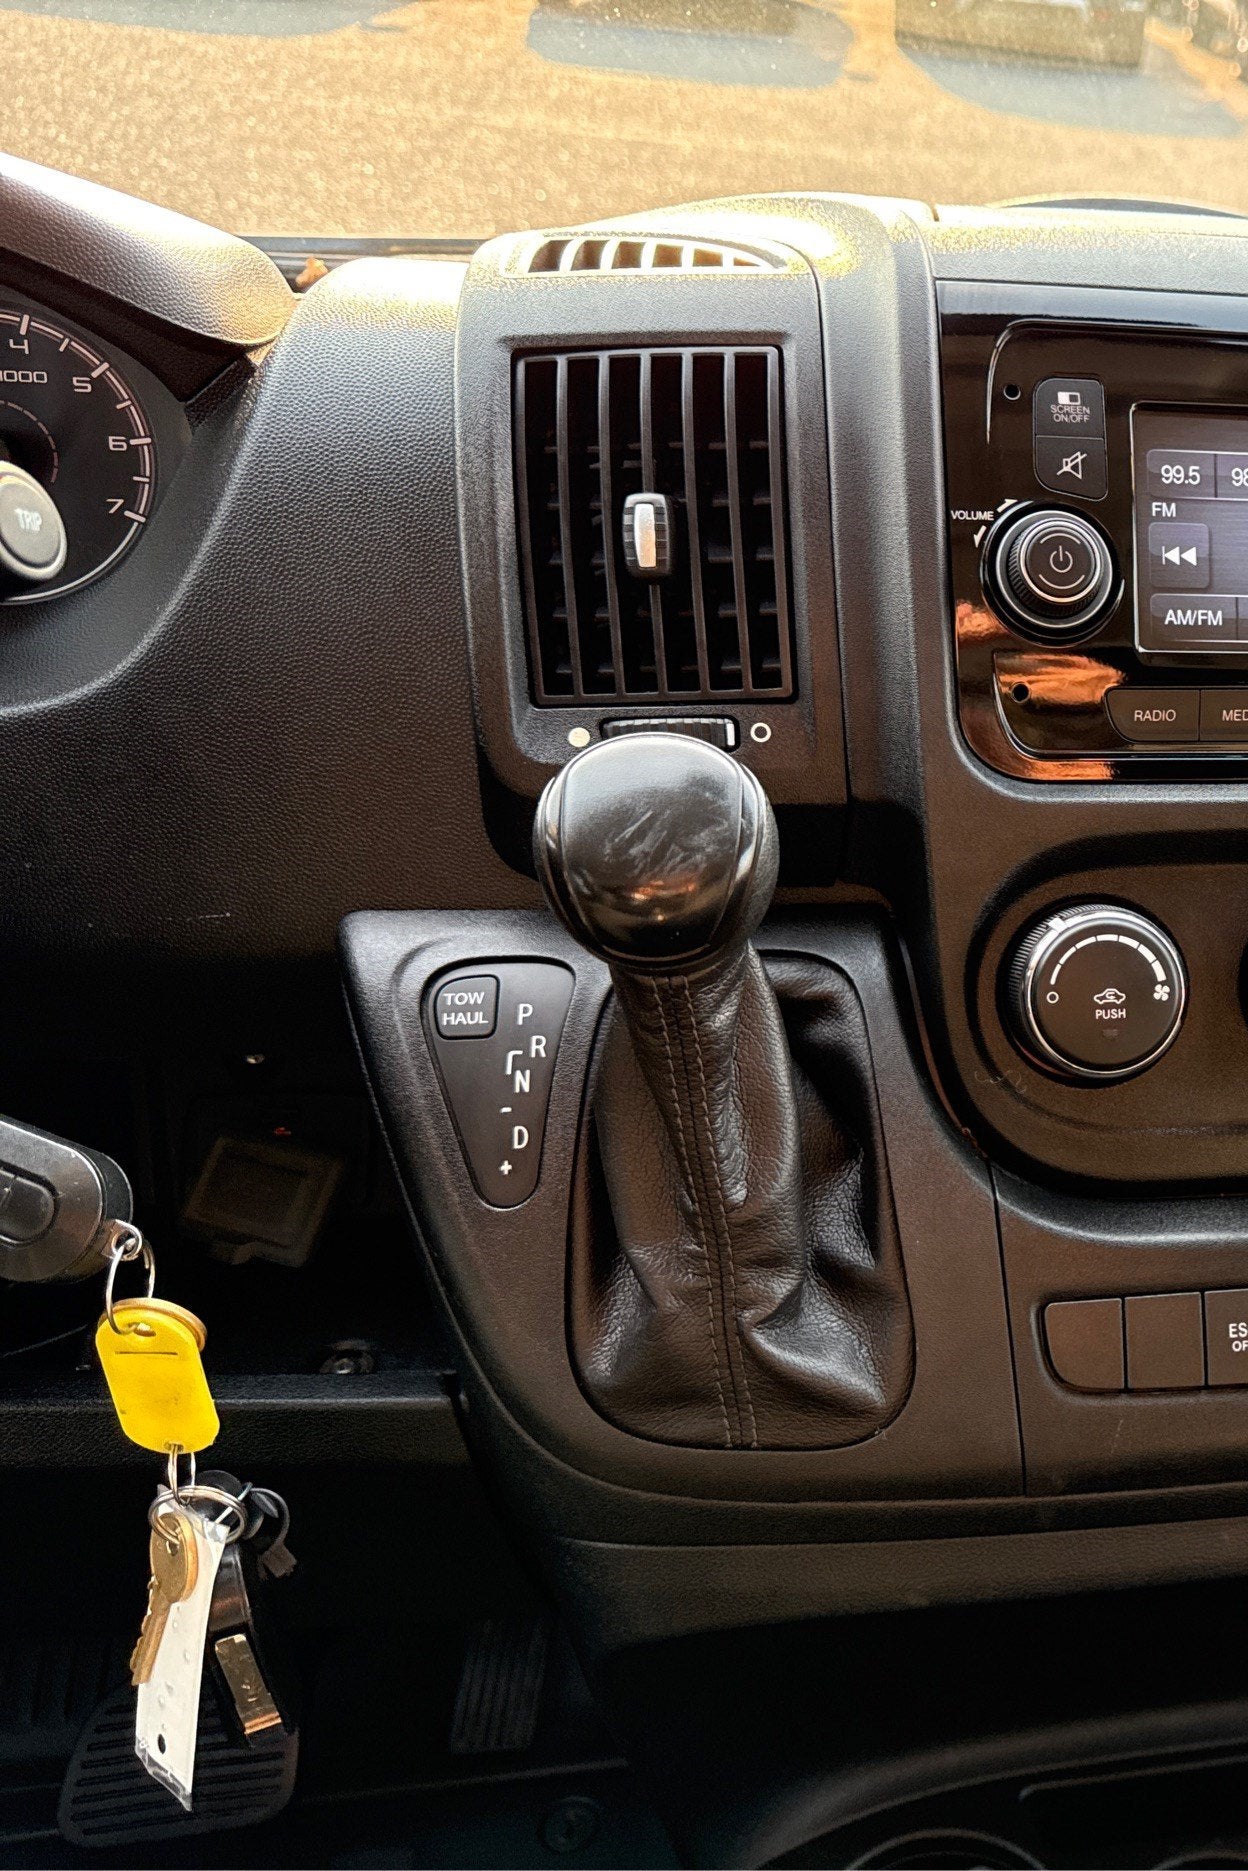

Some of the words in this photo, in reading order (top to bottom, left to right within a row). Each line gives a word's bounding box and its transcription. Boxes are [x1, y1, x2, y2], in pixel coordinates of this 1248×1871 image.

[9, 339, 29, 354] 4
[73, 376, 92, 392] 5
[1050, 404, 1091, 415] SCREEN
[1053, 413, 1090, 423] ON/OFF
[109, 436, 127, 451] 6
[1161, 465, 1200, 485] 99.5
[106, 499, 125, 514] 7
[1152, 502, 1176, 517] FM
[14, 508, 42, 532] TRIP
[951, 510, 994, 520] VOLUME
[1165, 609, 1222, 625] AM/FM
[1135, 710, 1176, 721] RADIO
[443, 992, 484, 1005] TOW
[442, 1012, 488, 1025] HAUL
[518, 1004, 533, 1025] P
[1096, 1009, 1126, 1019] PUSH
[531, 1035, 546, 1057] R
[515, 1070, 530, 1093] N
[514, 1126, 528, 1149] D
